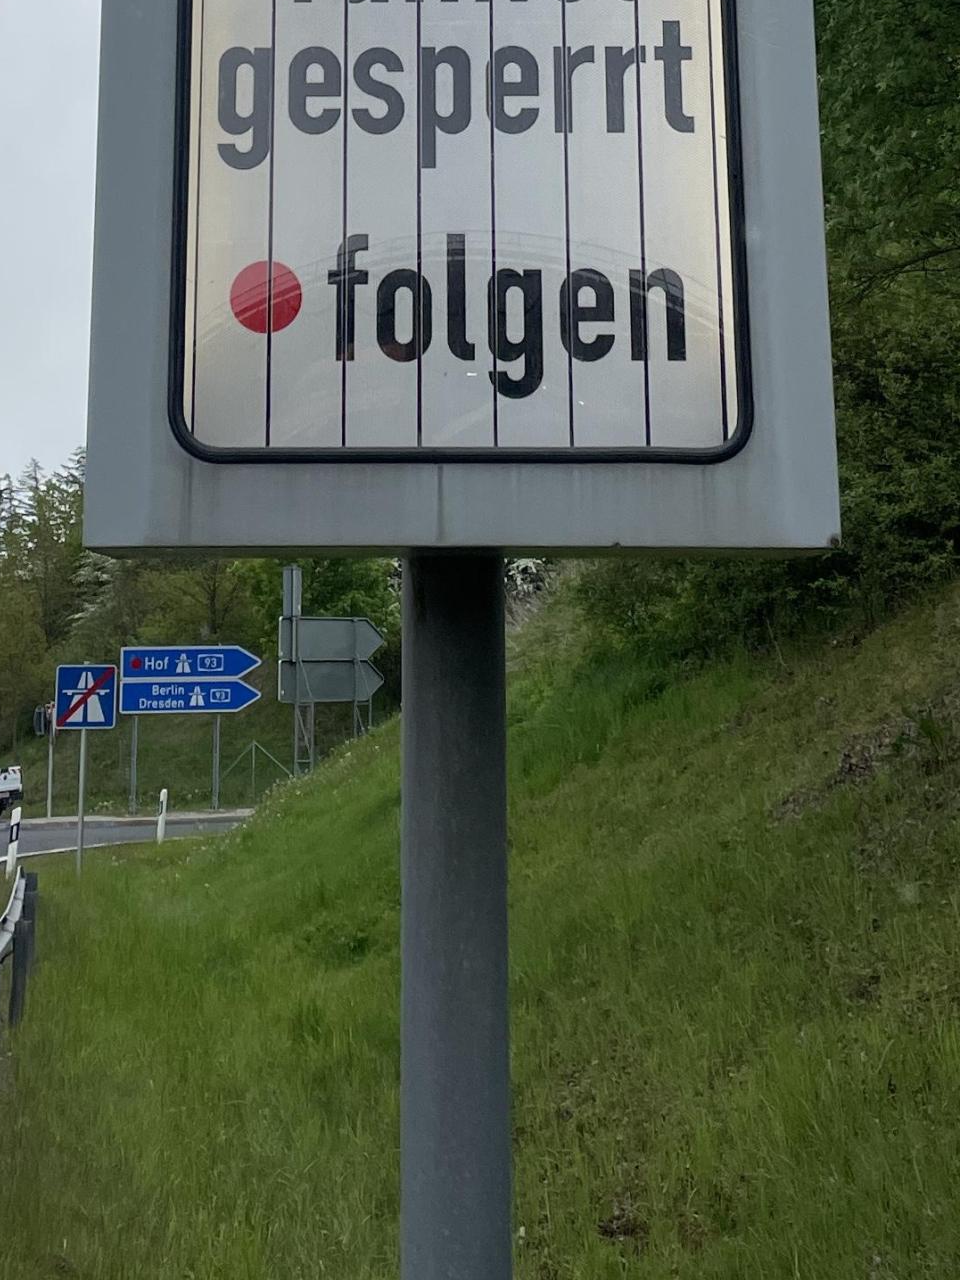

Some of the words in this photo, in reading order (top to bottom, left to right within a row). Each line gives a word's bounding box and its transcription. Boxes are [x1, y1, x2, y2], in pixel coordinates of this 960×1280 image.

[216, 20, 695, 170] gesperrt
[327, 233, 687, 399] folgen
[144, 656, 169, 670] Hof
[204, 657, 217, 668] 93
[151, 684, 185, 696] Berlin
[215, 691, 226, 700] 93
[139, 698, 185, 709] Dresden
